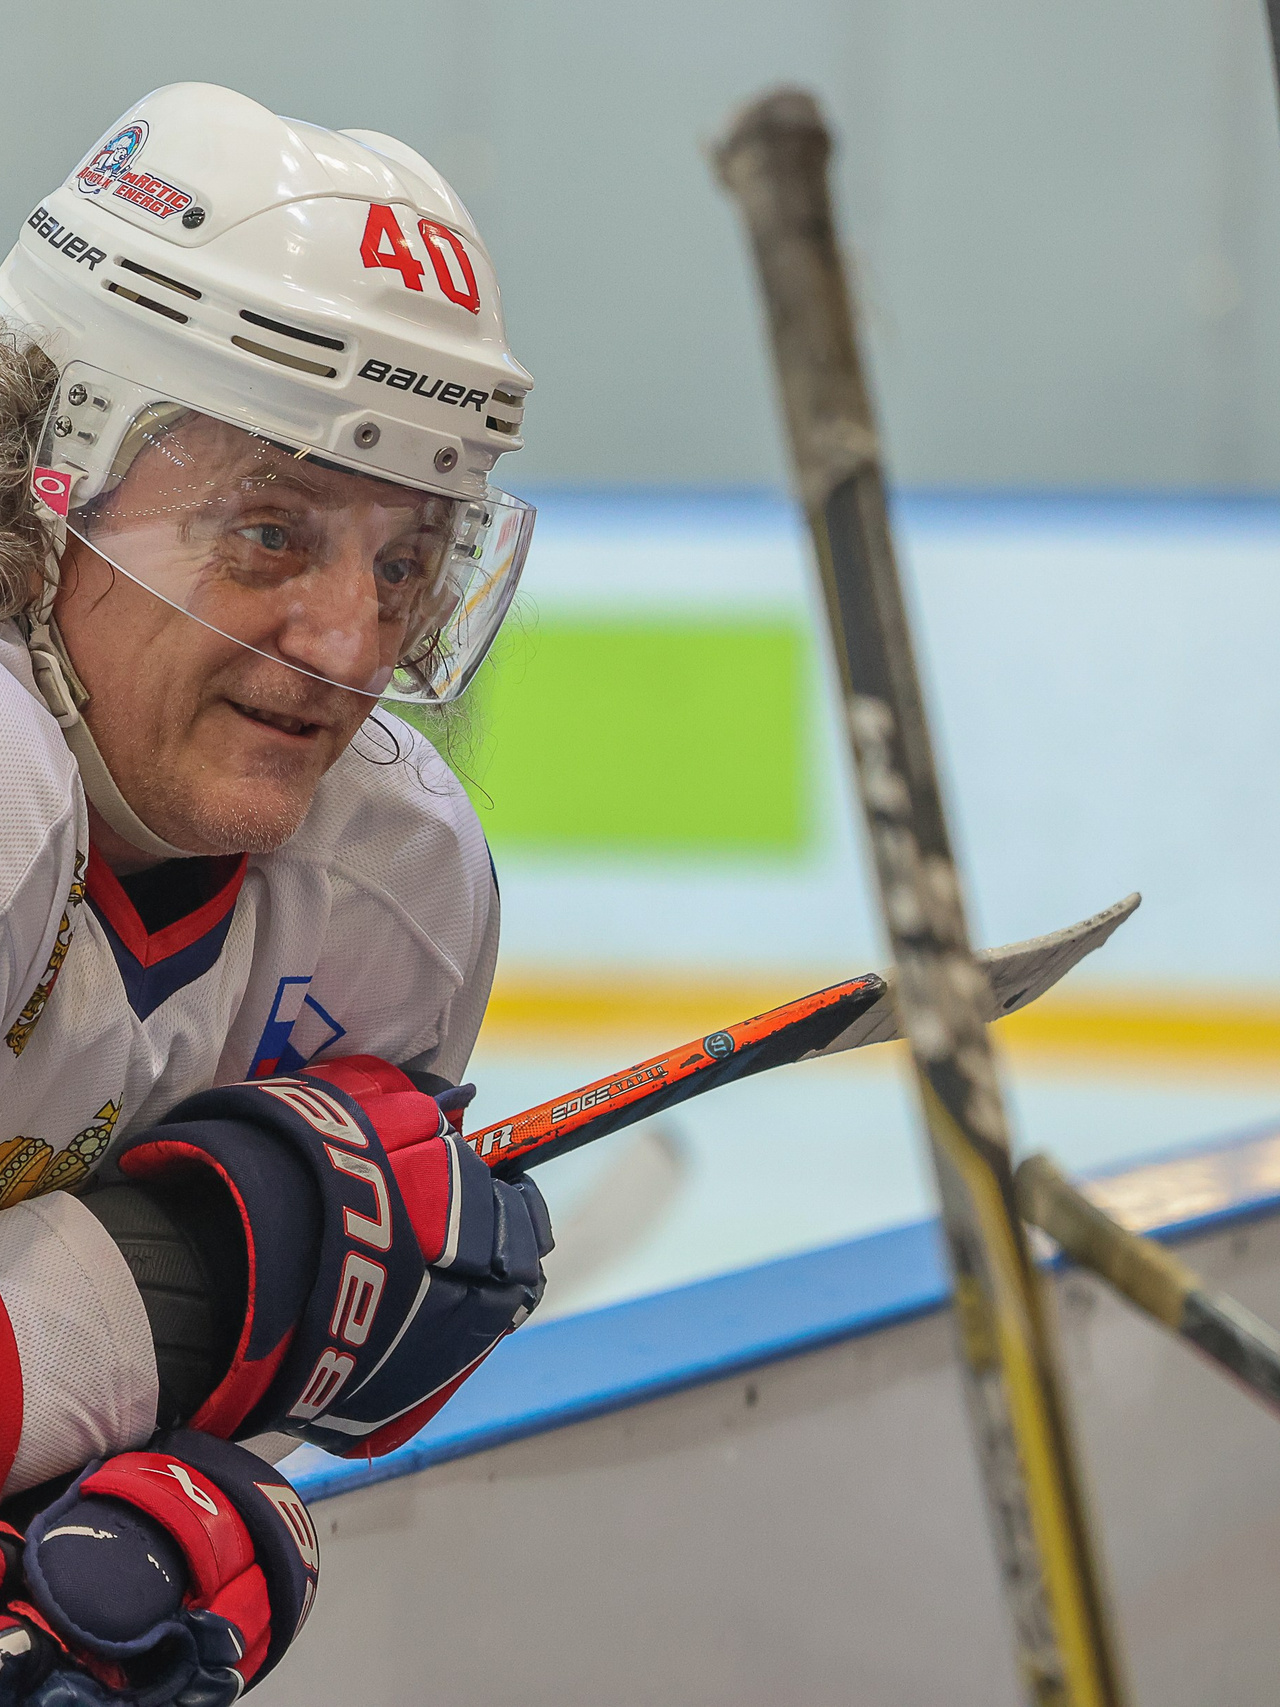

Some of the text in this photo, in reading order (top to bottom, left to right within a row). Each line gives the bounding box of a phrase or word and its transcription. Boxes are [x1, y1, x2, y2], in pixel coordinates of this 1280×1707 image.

[115, 184, 175, 217] ENERGY
[121, 171, 190, 210] ARCTIC
[360, 203, 480, 315] 40
[357, 358, 489, 412] BAUER
[466, 1065, 664, 1157] R EDGE TAPER
[219, 1077, 392, 1428] BAUE
